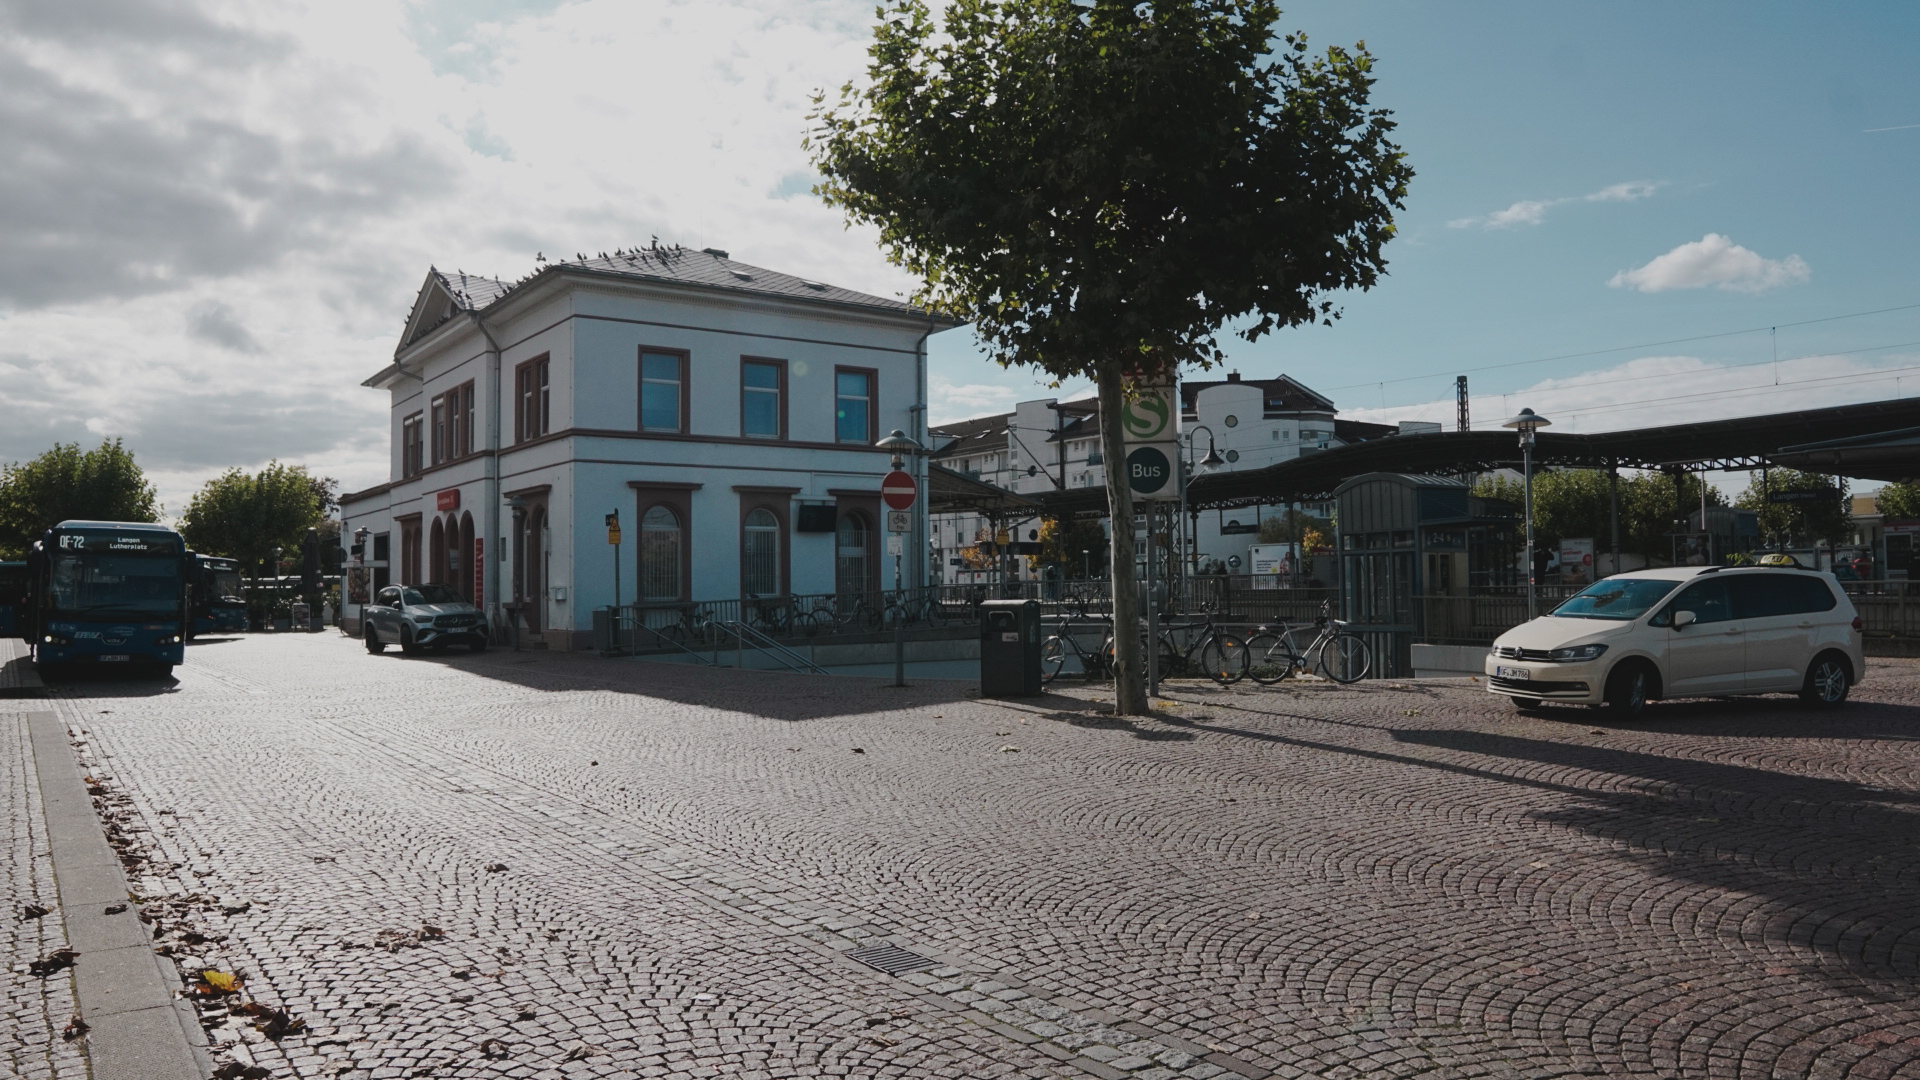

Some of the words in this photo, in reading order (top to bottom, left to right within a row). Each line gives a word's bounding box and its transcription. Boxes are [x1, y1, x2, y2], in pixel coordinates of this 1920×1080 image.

[1129, 394, 1162, 434] S
[1132, 463, 1161, 478] Bus
[59, 535, 85, 549] OF-72
